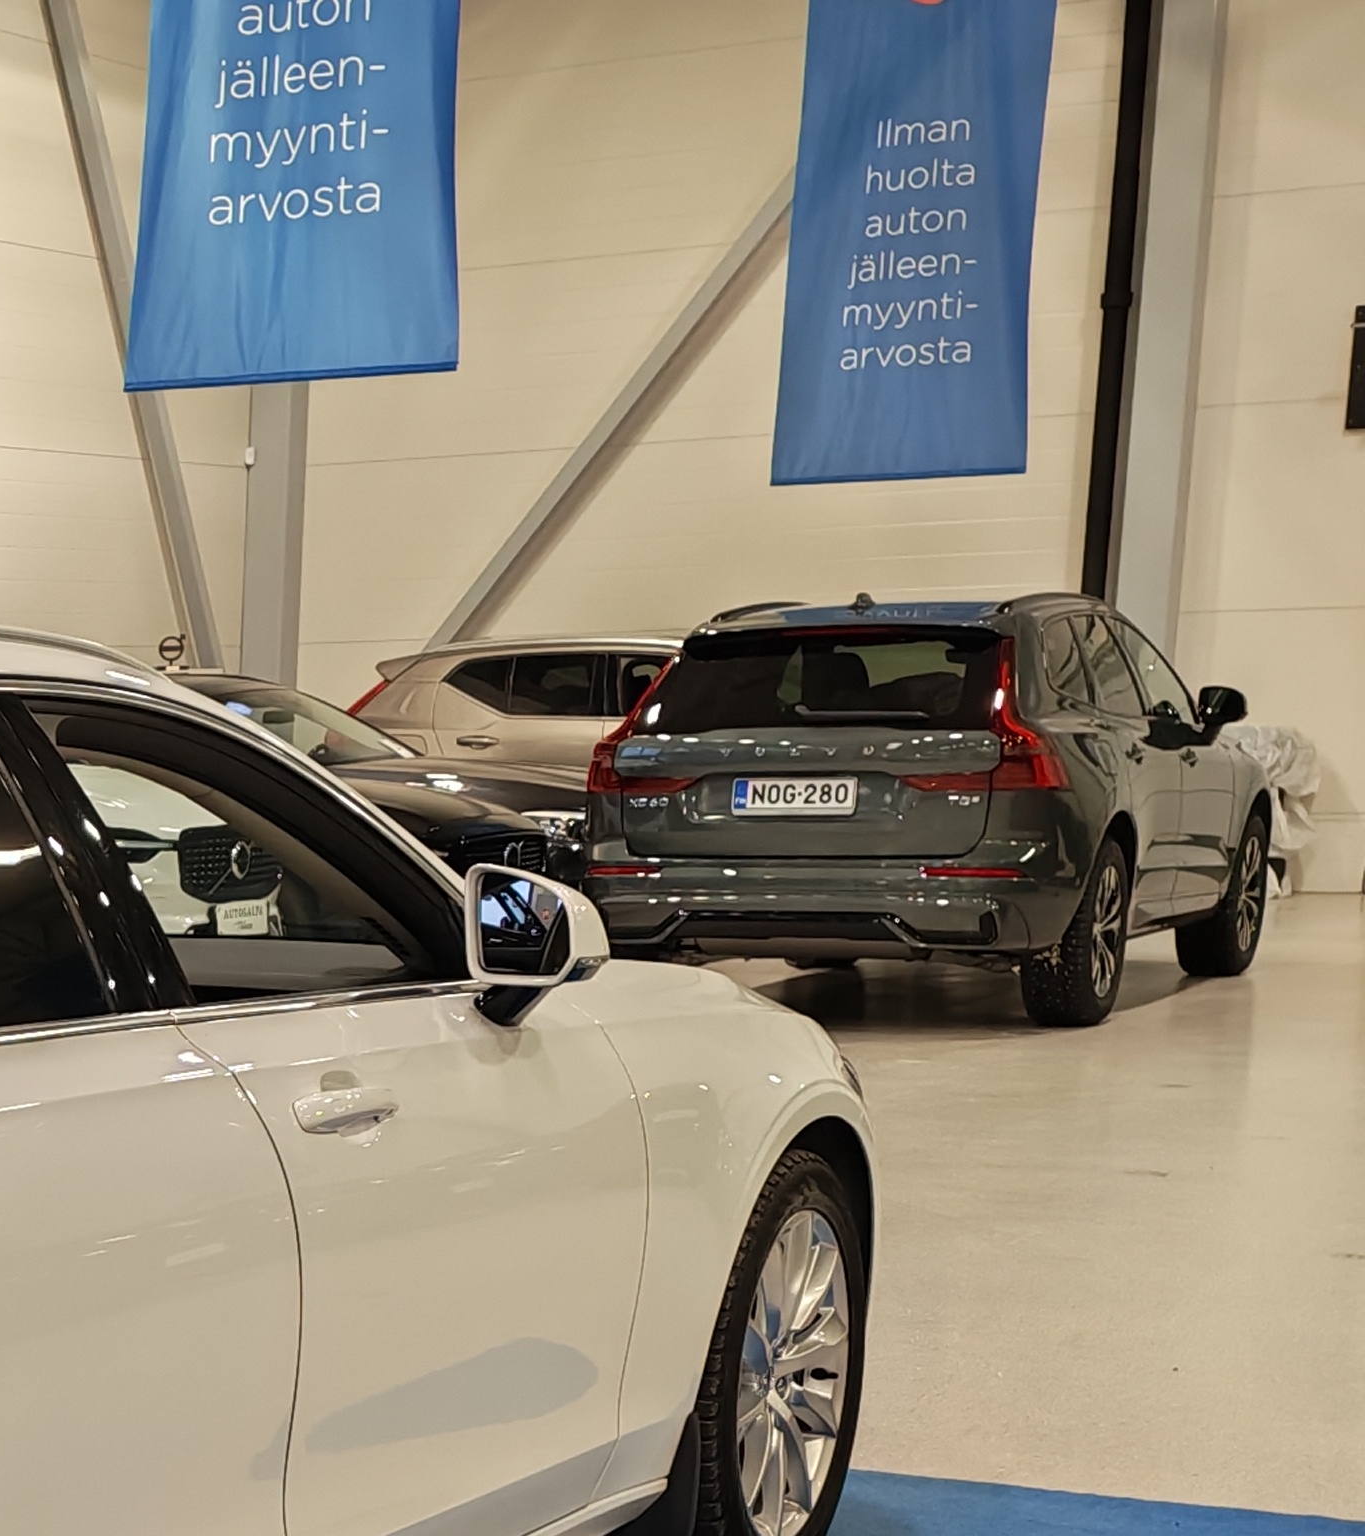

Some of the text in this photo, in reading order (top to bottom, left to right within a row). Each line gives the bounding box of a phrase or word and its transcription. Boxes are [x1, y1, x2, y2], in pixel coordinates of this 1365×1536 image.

[236, 0, 370, 36] auton
[214, 53, 387, 109] jälleen-
[209, 108, 389, 169] myynti-
[876, 117, 970, 149] Ilman
[864, 157, 976, 194] huolta
[208, 176, 382, 226] arvosta
[864, 206, 968, 239] auton
[846, 249, 978, 290] jälleen-
[842, 289, 979, 331] myynti-
[839, 336, 972, 371] arvosta
[750, 783, 850, 805] NOG-280
[223, 905, 263, 920] AUTOSALPA
